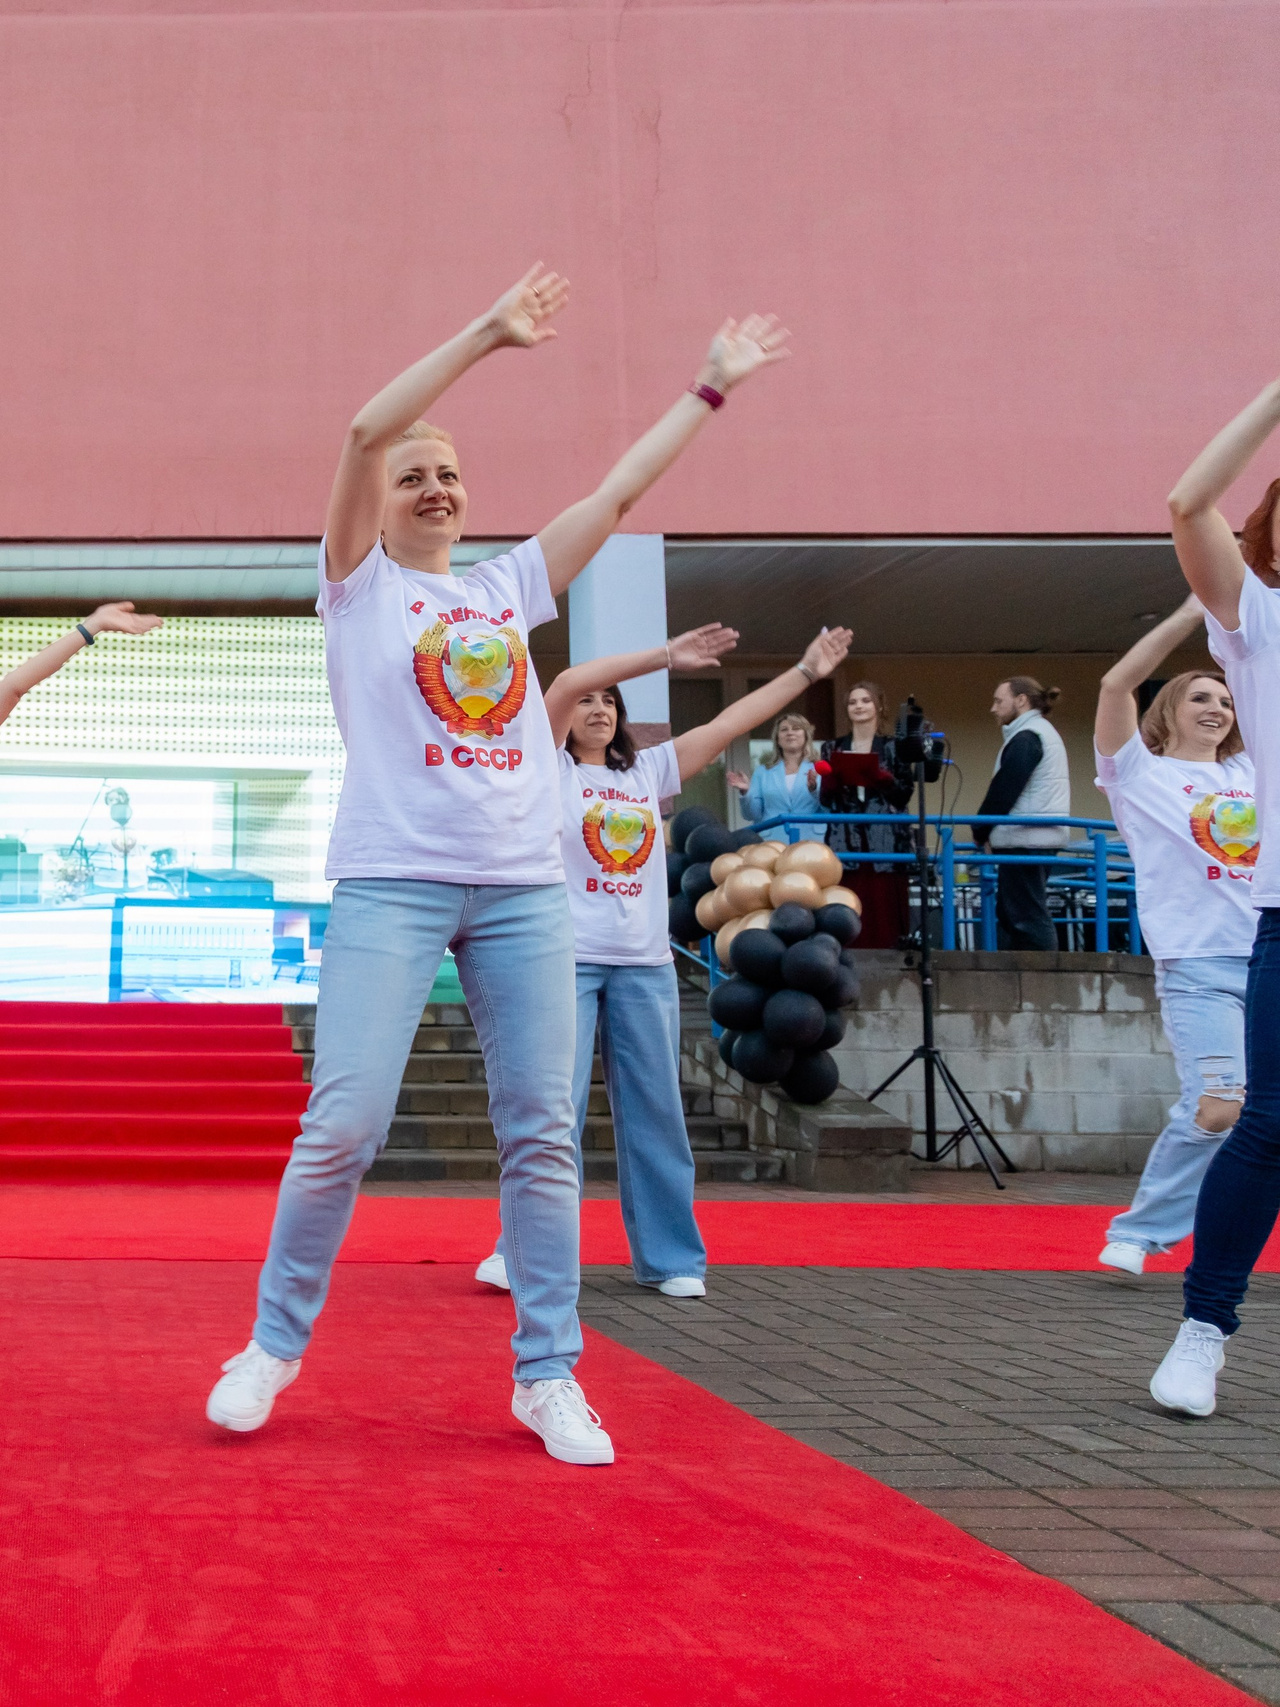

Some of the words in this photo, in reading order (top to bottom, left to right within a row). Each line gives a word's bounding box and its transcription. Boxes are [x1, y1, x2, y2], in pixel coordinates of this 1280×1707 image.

[410, 600, 515, 627] РДЁННАЯ
[425, 743, 445, 767] В
[451, 744, 523, 771] СССР
[1207, 865, 1221, 880] В
[586, 877, 599, 893] В
[602, 880, 643, 897] СССР
